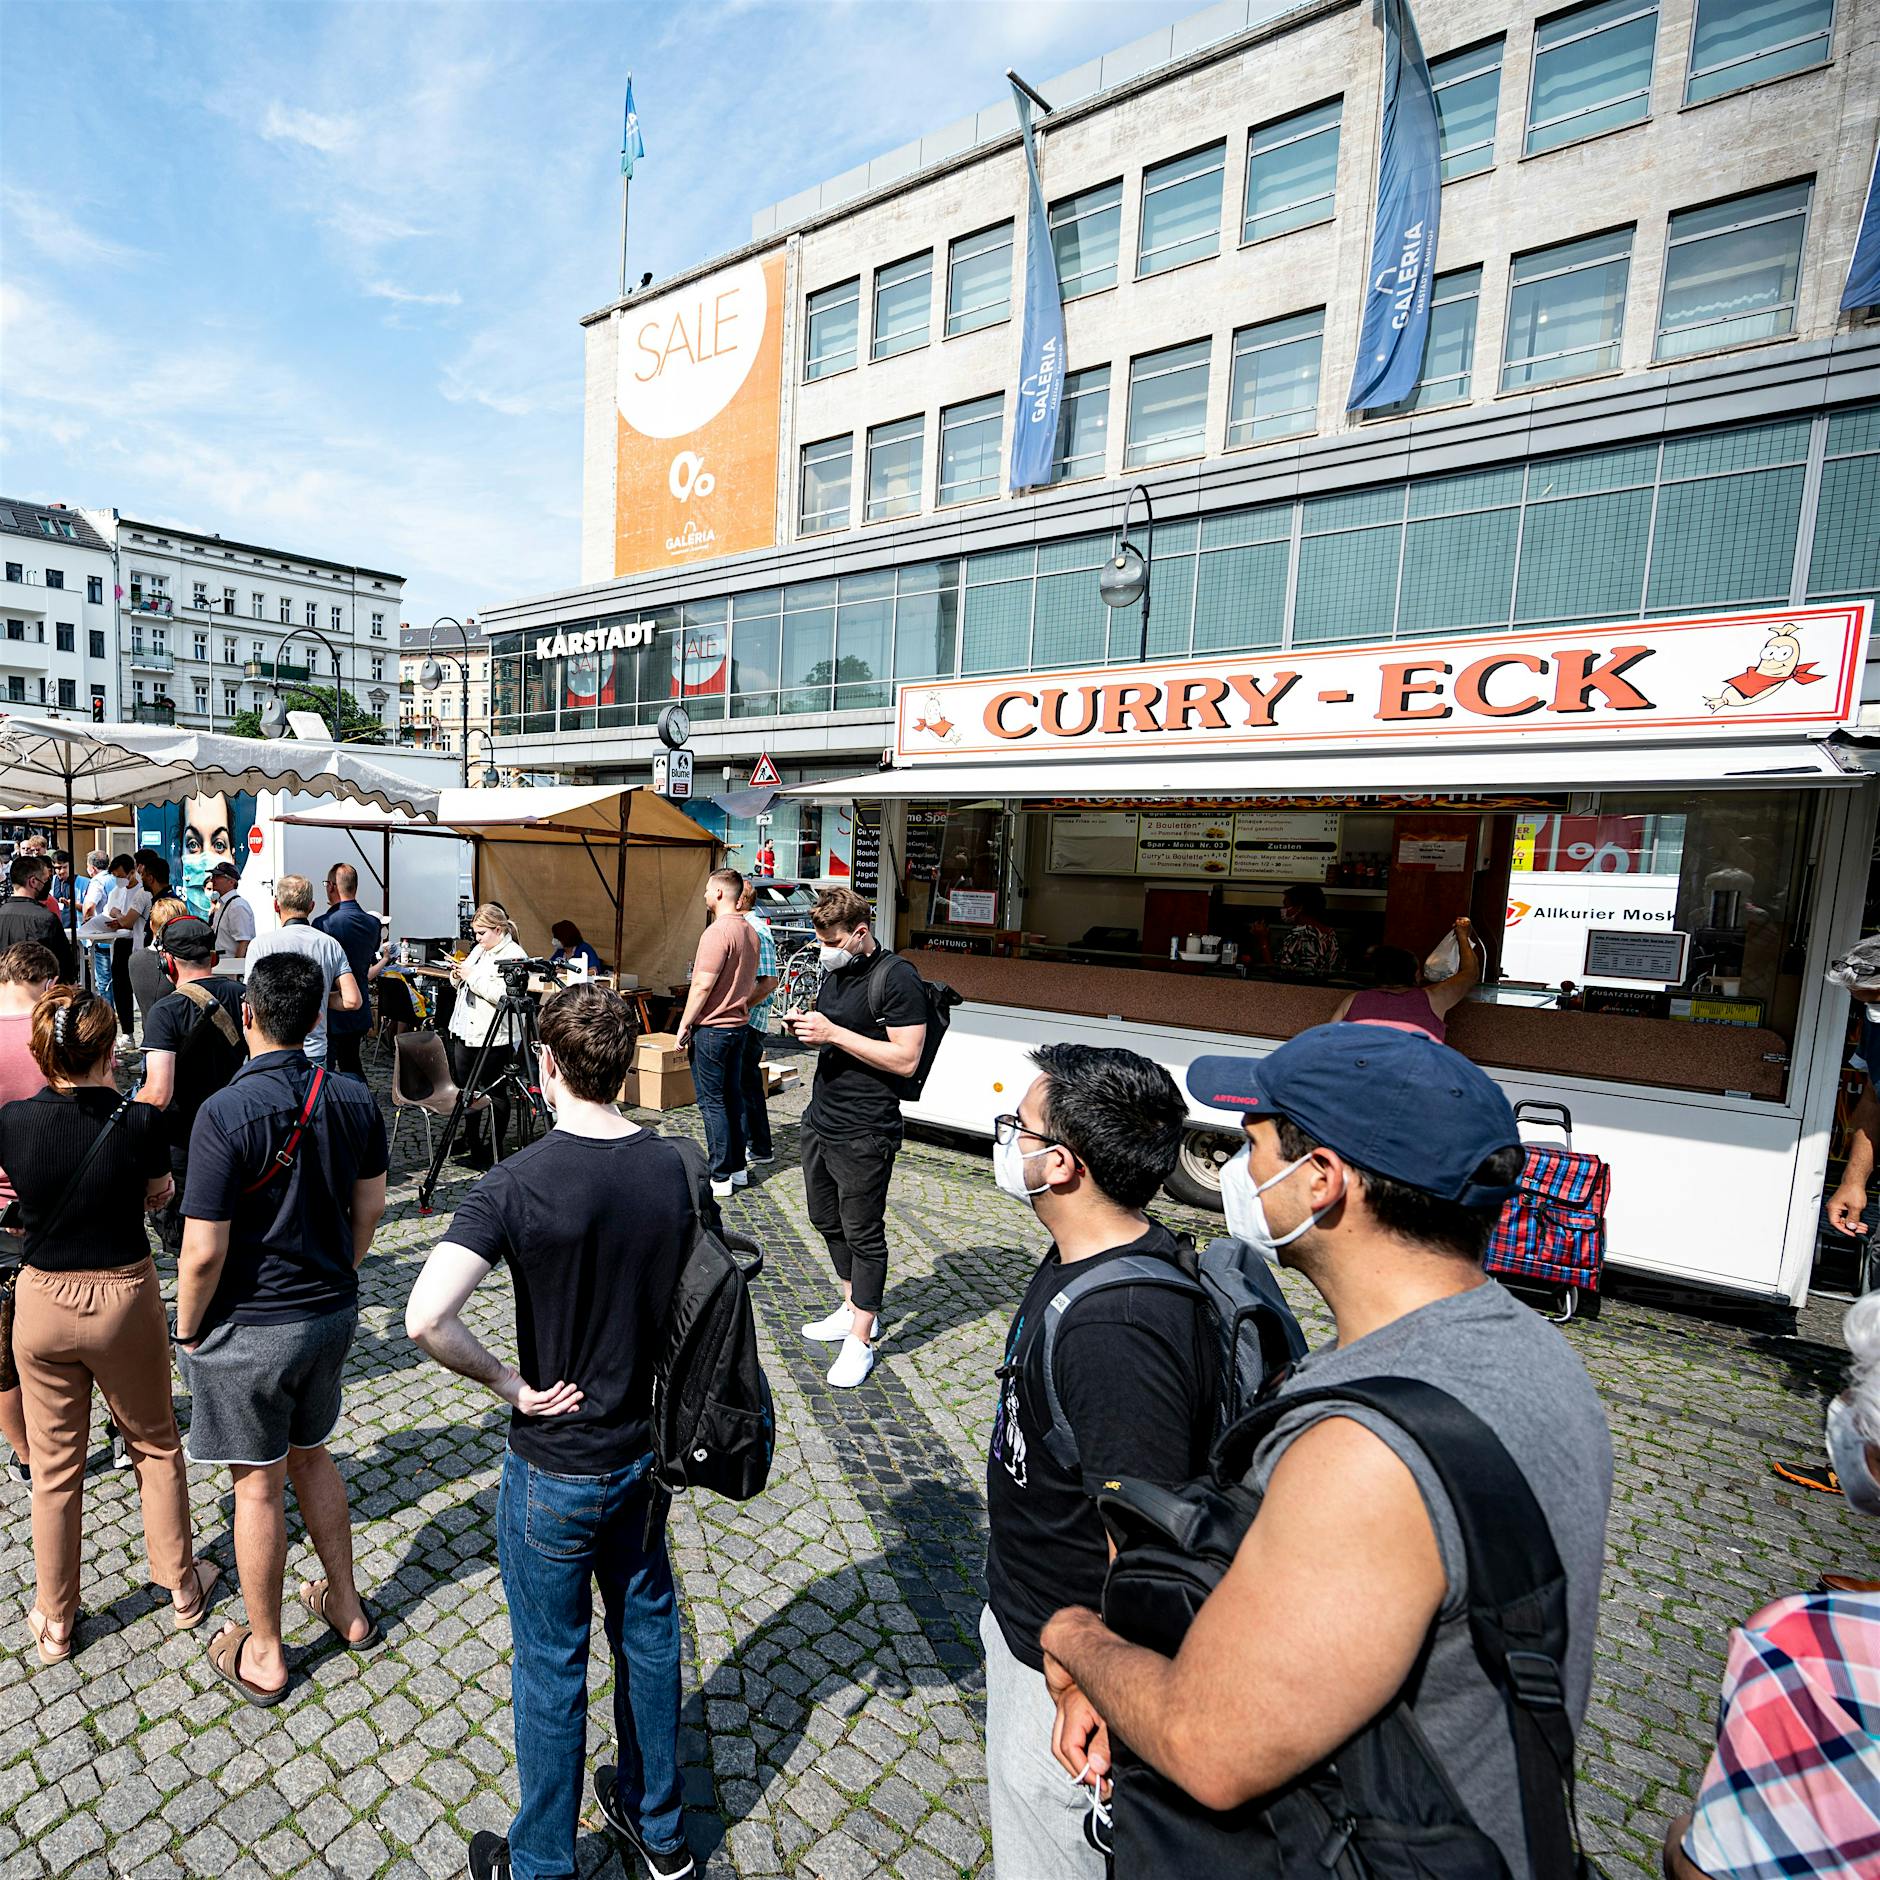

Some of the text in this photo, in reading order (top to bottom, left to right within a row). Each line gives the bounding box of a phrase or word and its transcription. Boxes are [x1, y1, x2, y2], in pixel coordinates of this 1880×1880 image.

[1391, 220, 1424, 330] GALERIA
[1416, 274, 1428, 316] KARSTADT
[634, 288, 740, 382] SALE
[1031, 336, 1056, 424] GALERIA
[666, 530, 716, 550] GALERIA
[536, 620, 656, 660] KARSTADT
[675, 633, 718, 662] SALE
[982, 670, 1303, 741] CURRY
[1376, 644, 1657, 721] ECK
[671, 768, 690, 778] Blume
[250, 836, 262, 844] STOP
[1267, 842, 1302, 850] Zutaten
[1534, 907, 1615, 920] Allkurier
[928, 938, 968, 948] ACHTUNG
[1591, 990, 1656, 1000] ZUSATZSTOFFE
[1212, 1094, 1259, 1106] ARTENGO
